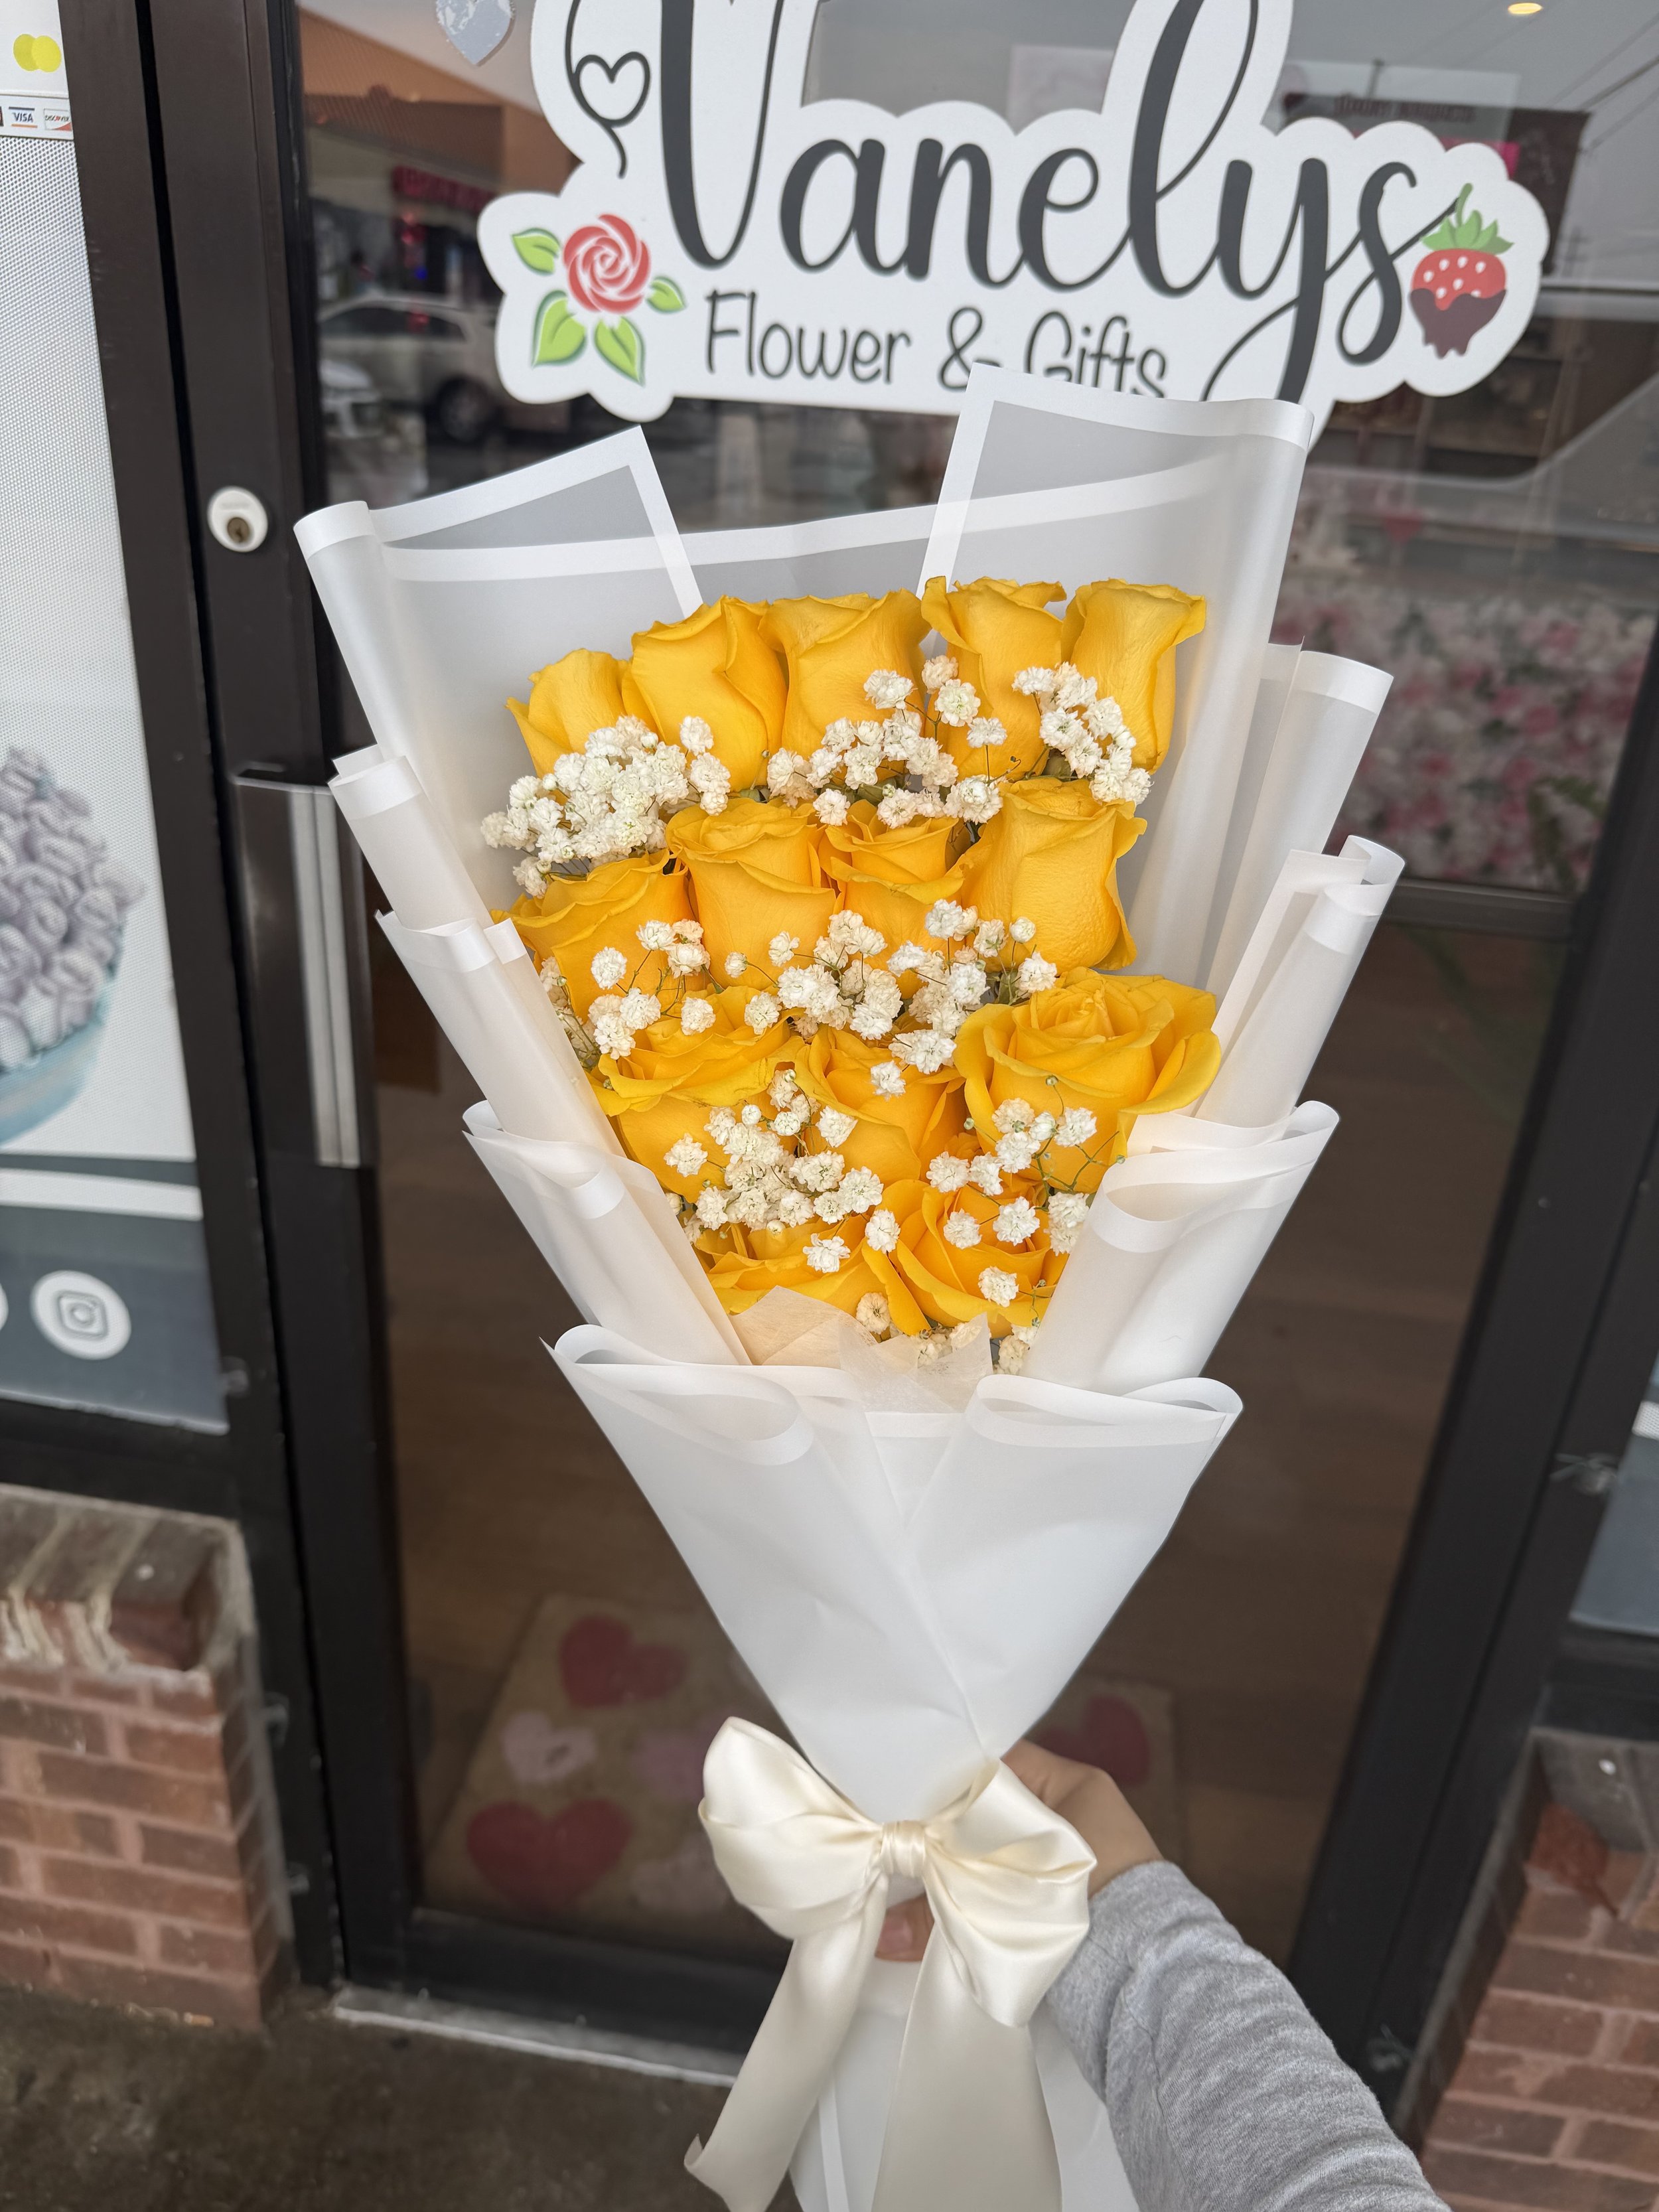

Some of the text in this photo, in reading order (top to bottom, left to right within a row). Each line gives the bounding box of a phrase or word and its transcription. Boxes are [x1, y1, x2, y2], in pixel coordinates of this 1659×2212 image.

[13, 112, 34, 123] VISA
[564, 0, 1459, 401] Vanelys
[705, 290, 1166, 398] Flower & Gifts
